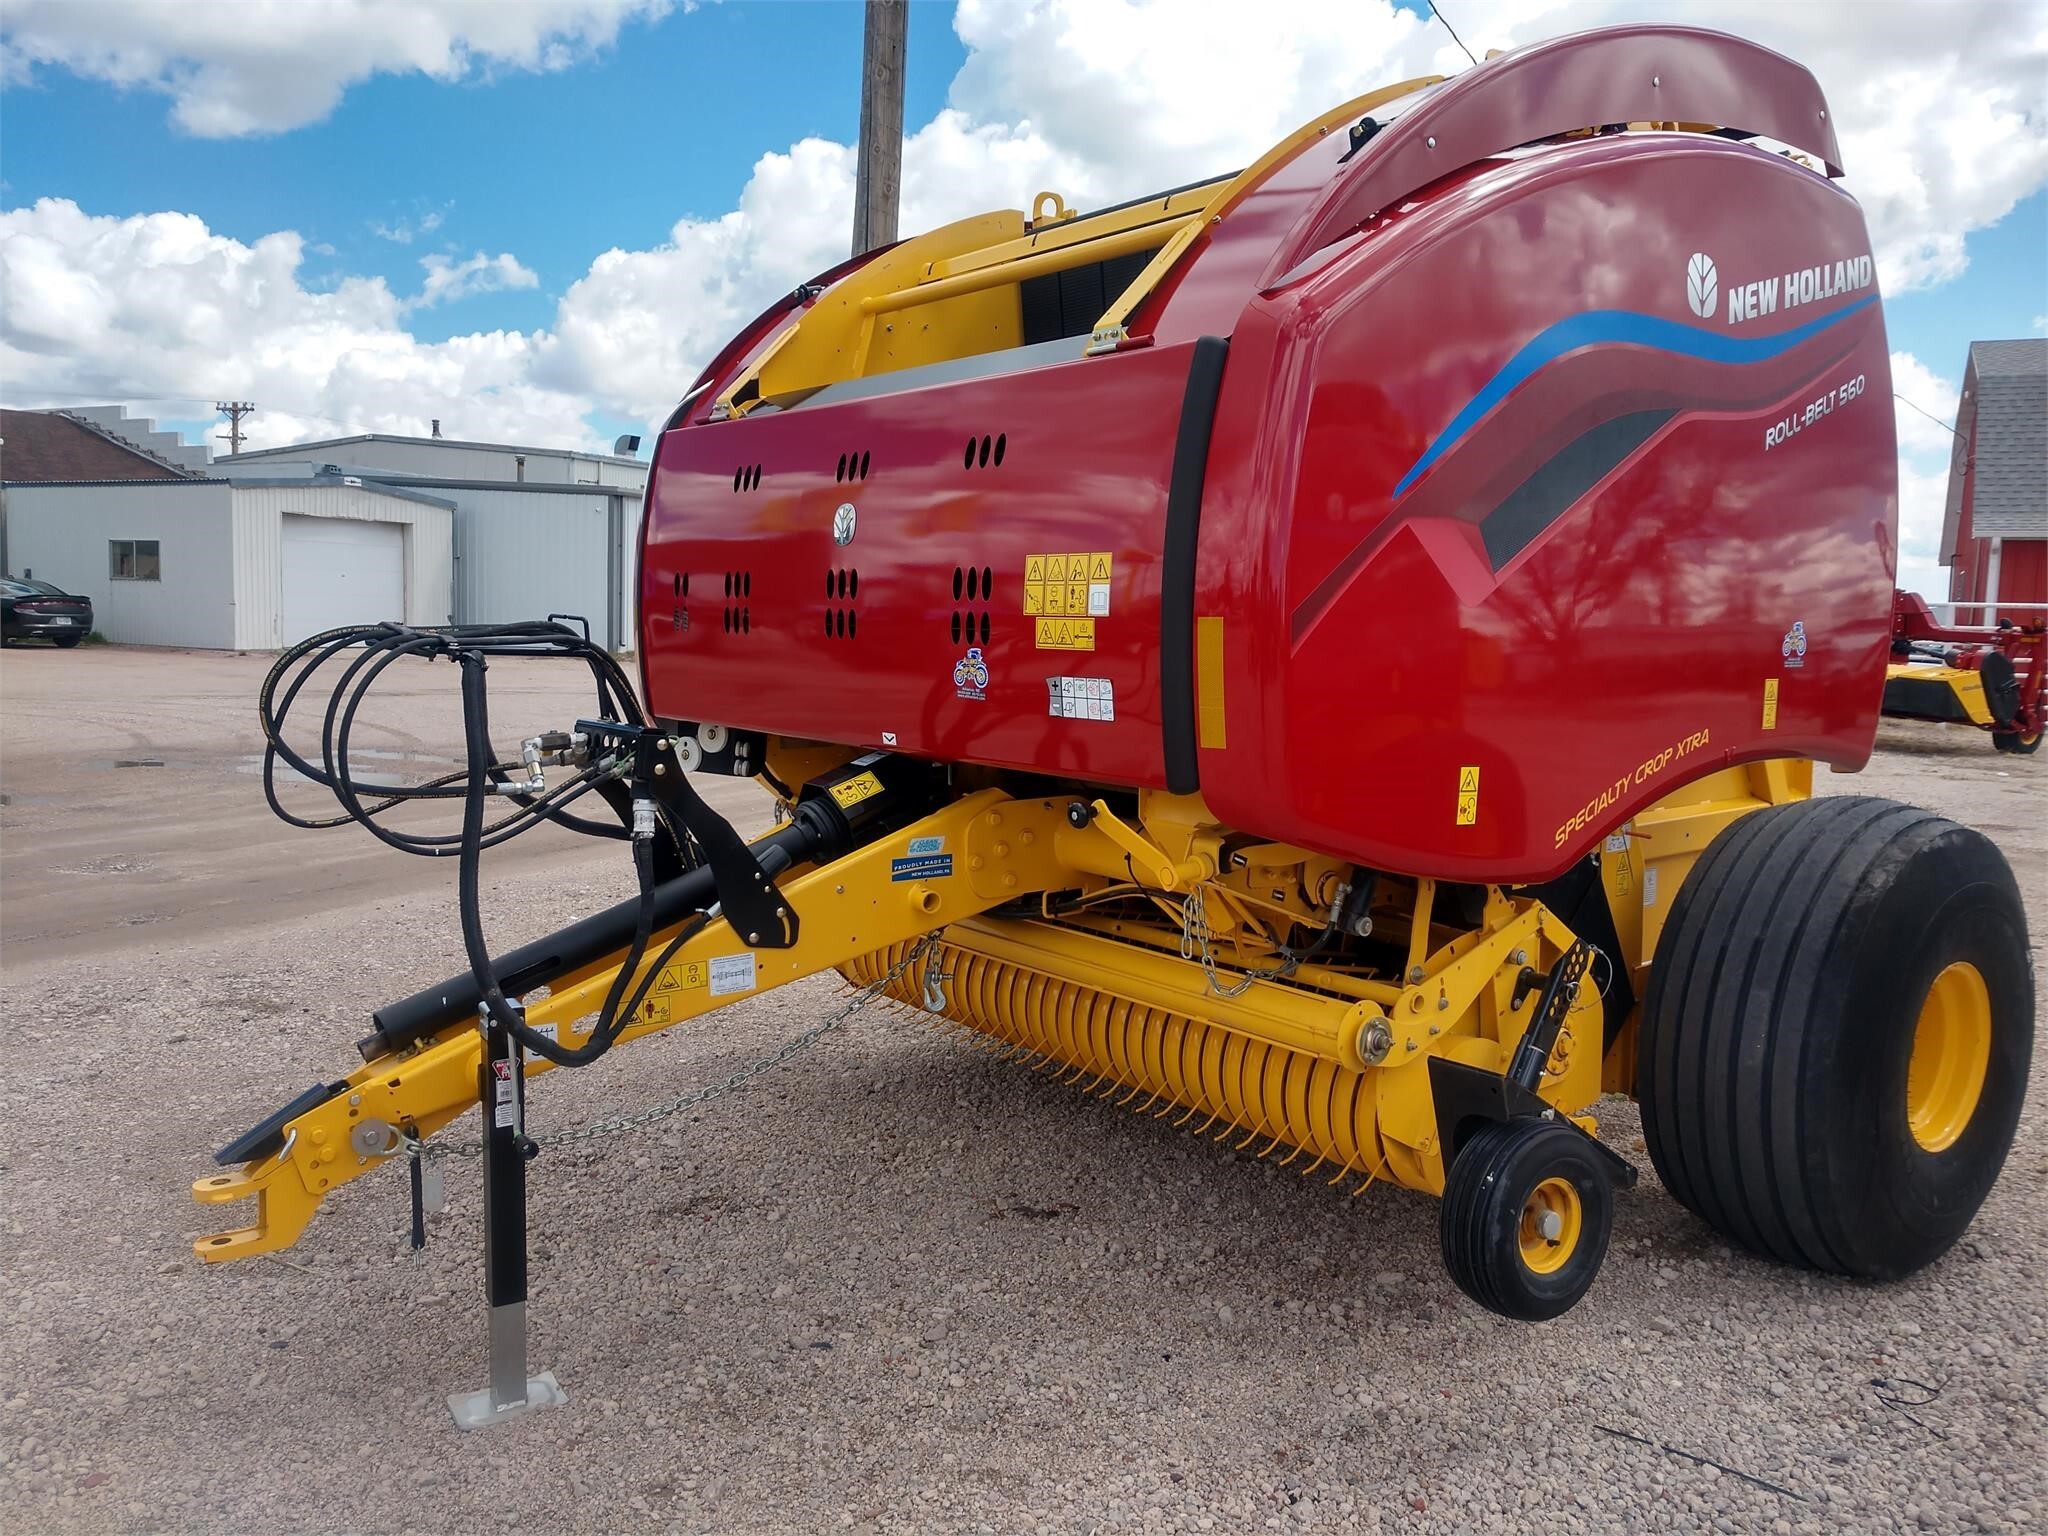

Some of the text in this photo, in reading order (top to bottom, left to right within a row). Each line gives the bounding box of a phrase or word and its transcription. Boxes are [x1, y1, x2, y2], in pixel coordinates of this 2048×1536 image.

[1728, 254, 1873, 325] NEW HOLLAND
[1764, 374, 1866, 451] ROLL-BELT 560
[1555, 728, 1709, 850] SPECIALTY CROP XTRA
[894, 861, 923, 871] PROUDLY
[924, 858, 942, 866] MADE
